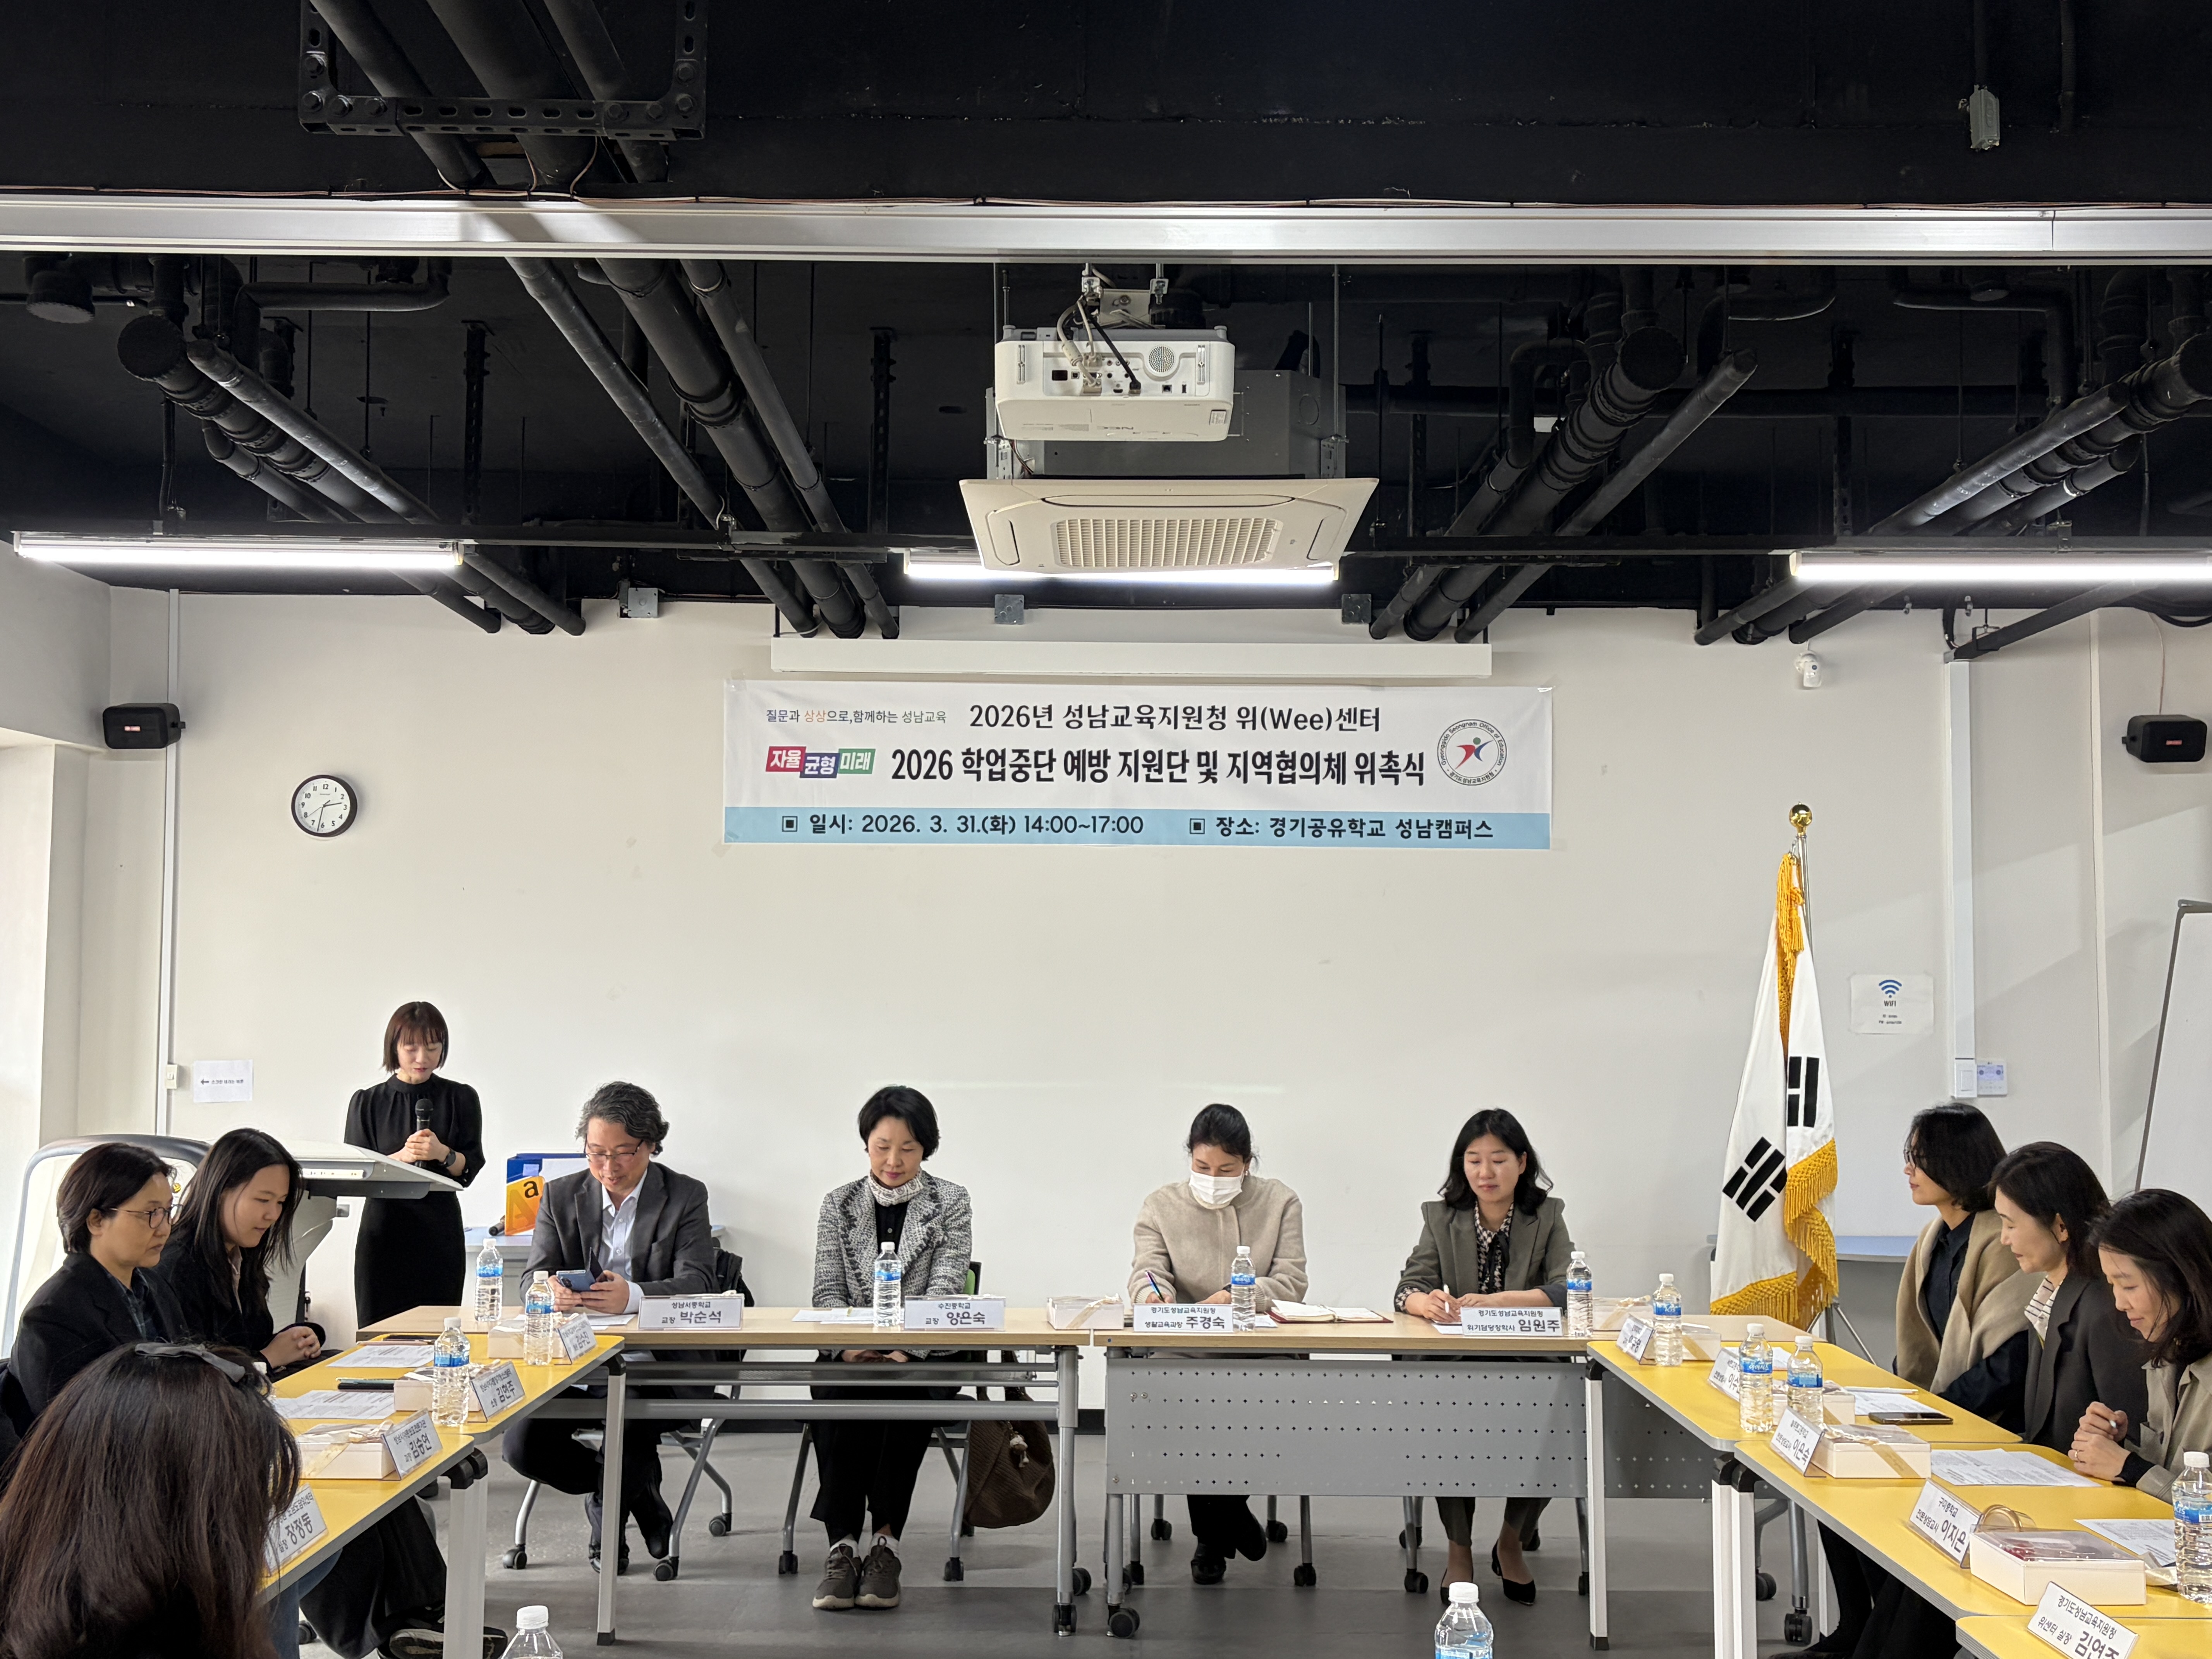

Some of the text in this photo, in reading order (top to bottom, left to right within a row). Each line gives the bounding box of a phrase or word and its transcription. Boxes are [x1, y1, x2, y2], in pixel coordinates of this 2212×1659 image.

[766, 709, 800, 723] 질문과
[902, 711, 947, 723] 성남교육
[970, 704, 1379, 732] 2026년 성남교육지원청 위(Wee)센터
[1449, 722, 1477, 733] Seongnam
[1479, 722, 1494, 734] Office
[770, 750, 871, 775] 자율 균형 미래
[891, 747, 1424, 786] 2026 학업중단 예방 지원단 및 지역협의체 위촉식
[810, 814, 1143, 835] 일시: 2026. 3. 31.(화) 14:00~17:00
[1216, 816, 1494, 840] 장소: 경기공유학교 성남캠퍼스
[680, 1311, 721, 1324] 박순석
[947, 1311, 985, 1326] 양은숙
[1186, 1317, 1224, 1329] 주경숙
[1518, 1319, 1560, 1332] 임원주
[496, 1380, 515, 1403] 김현주
[409, 1433, 432, 1458] 김승연
[1793, 1439, 1810, 1465] 이은숙
[1938, 1497, 1959, 1518] 구미중학교
[285, 1512, 313, 1545] 장정동
[1916, 1508, 1966, 1553] 전문상담교사 이지은
[2058, 1595, 2118, 1640] 경기도성남교육지원청
[2038, 1616, 2058, 1635] 위센터
[2057, 1630, 2072, 1645] 실장
